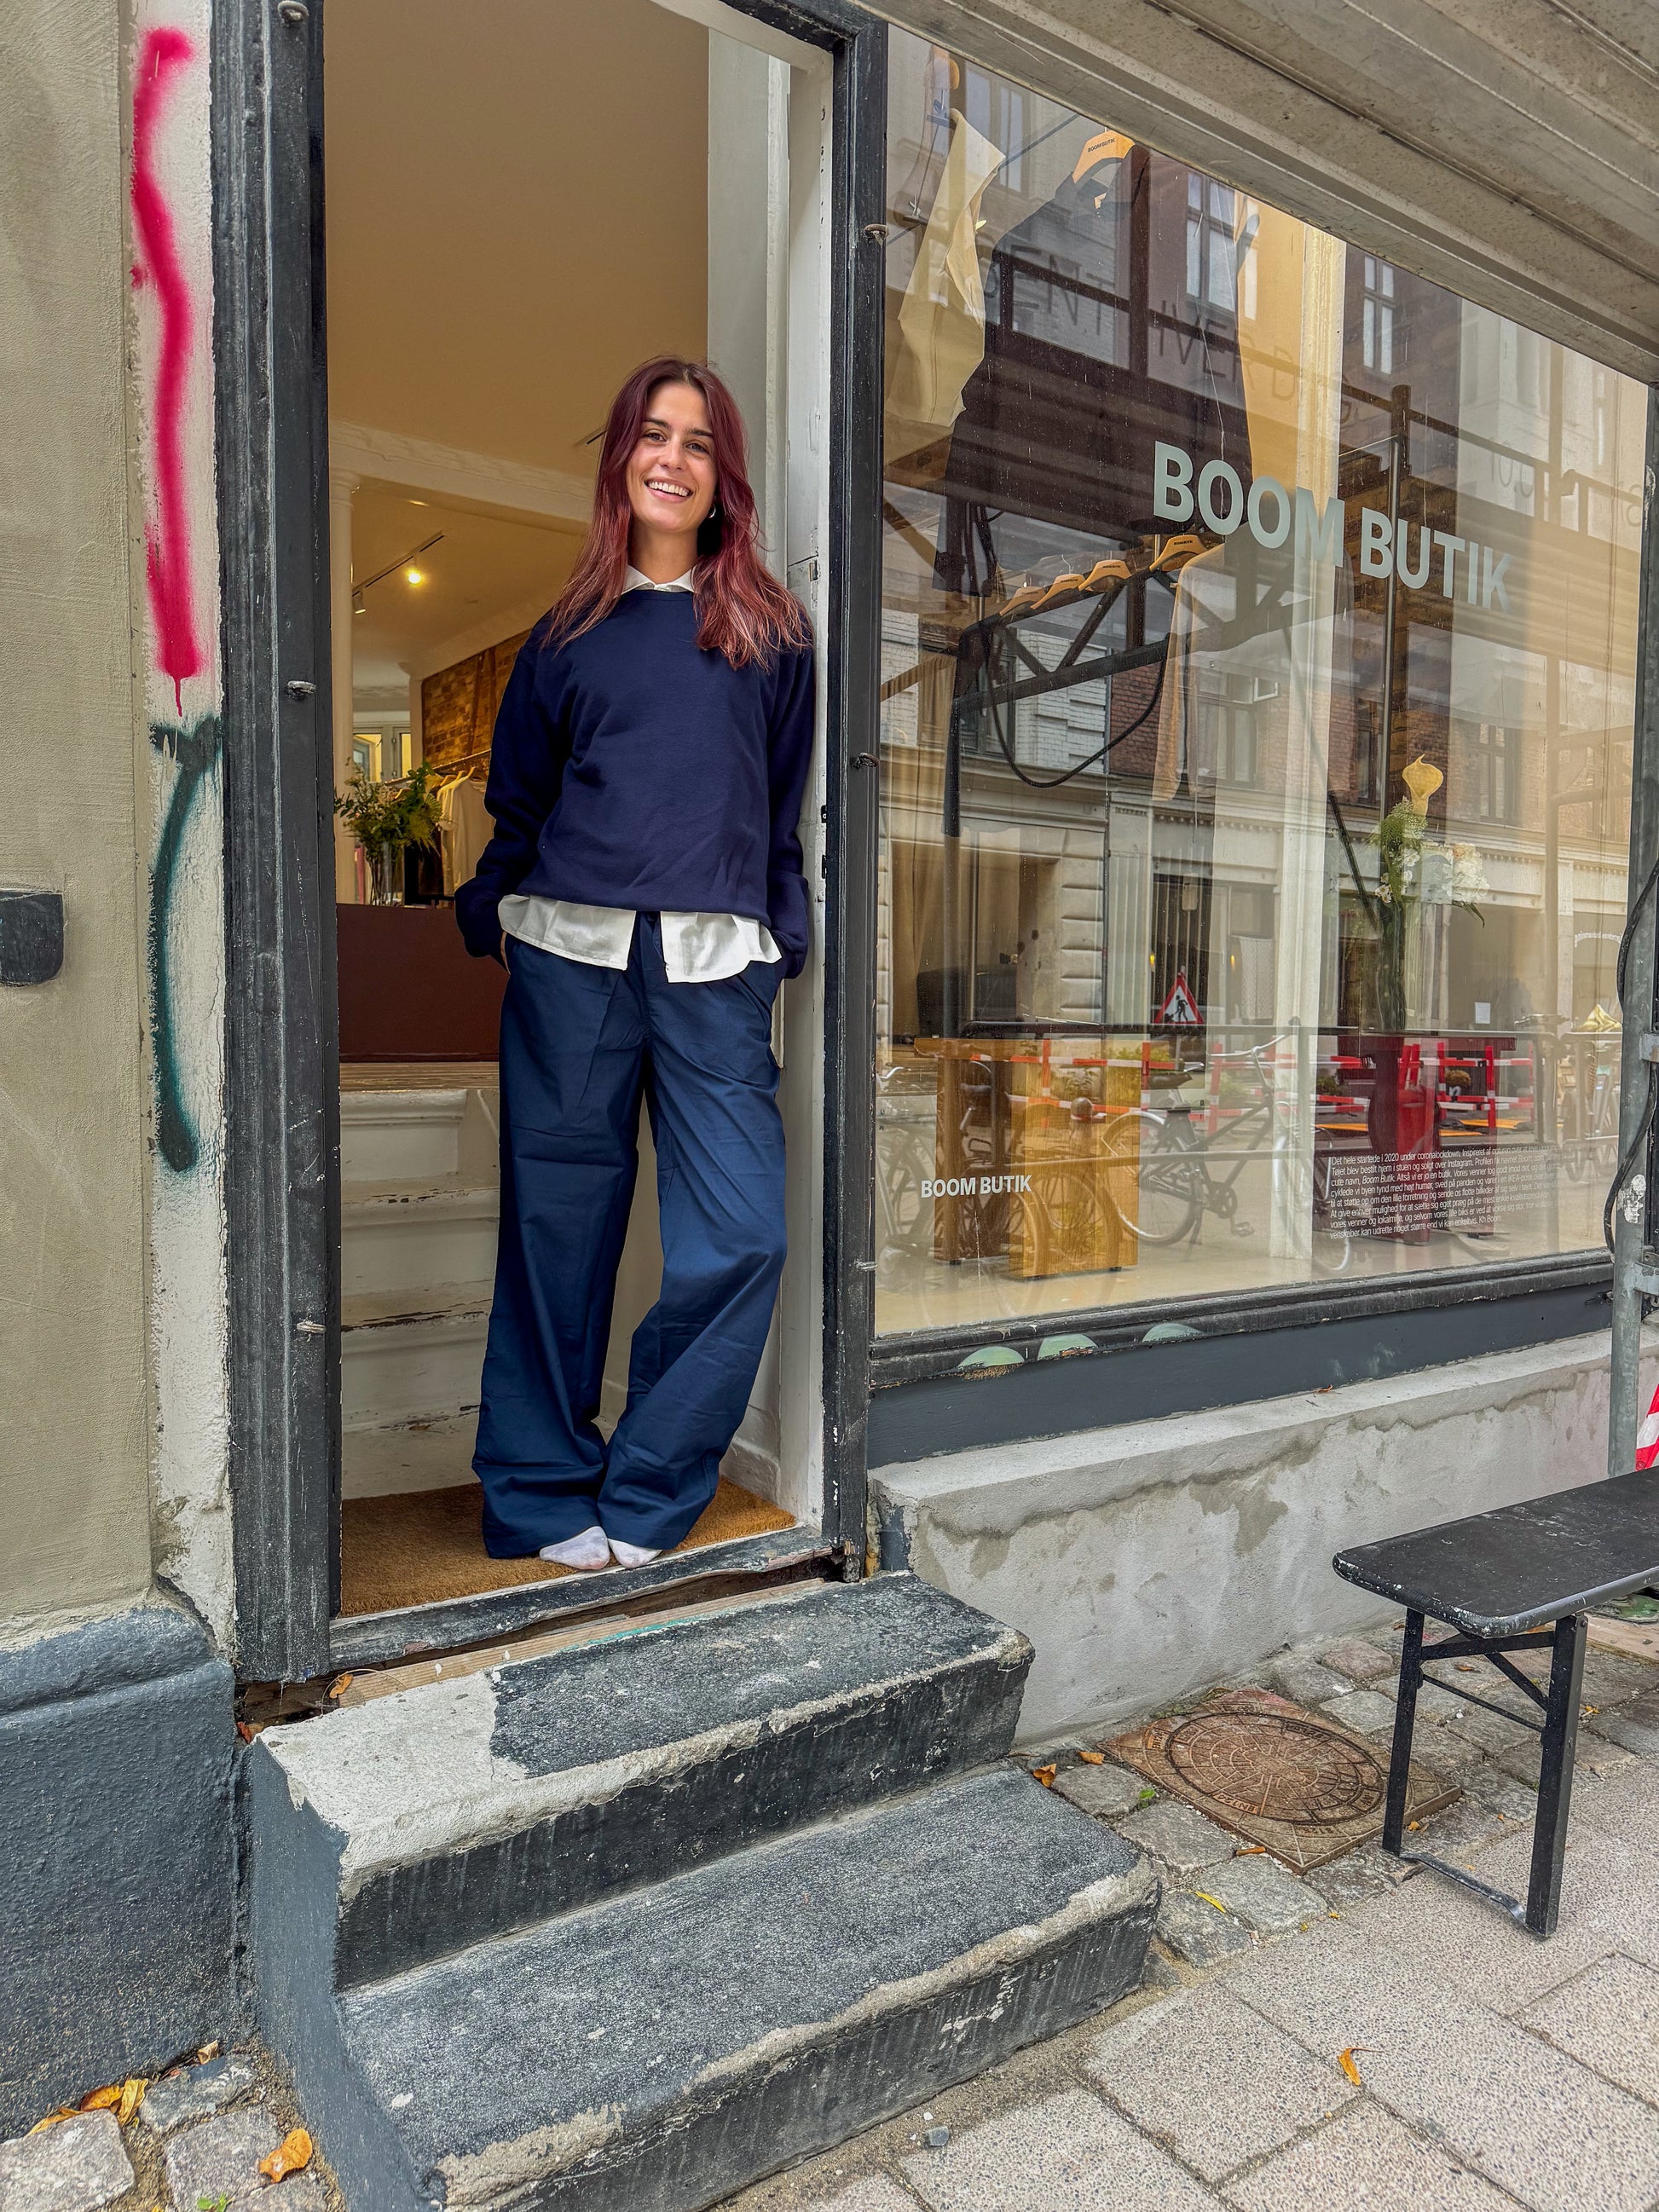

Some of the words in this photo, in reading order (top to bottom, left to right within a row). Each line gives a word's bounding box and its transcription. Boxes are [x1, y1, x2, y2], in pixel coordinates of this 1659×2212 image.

[1153, 441, 1344, 568] BOOM
[1361, 506, 1513, 614] BUTIK
[1332, 1157, 1342, 1165] Det
[1357, 1154, 1380, 1164] startede
[1400, 1152, 1416, 1161] under
[1417, 1150, 1460, 1159] coronalockdown.
[1462, 1148, 1485, 1158] Inspireret
[1331, 1178, 1344, 1187] cute
[1362, 1175, 1379, 1184] Boom
[1381, 1174, 1396, 1182] Butik.
[1396, 1172, 1410, 1181] Altså
[1424, 1171, 1429, 1181] jo
[1438, 1170, 1452, 1178] butik.
[1332, 1167, 1345, 1177] Tøjet
[1361, 1164, 1377, 1174] bestilt
[1378, 1164, 1391, 1174] hjem
[1421, 1162, 1434, 1170] solgt
[1448, 1160, 1473, 1169] Instagram.
[921, 1177, 976, 1198] BOOM
[980, 1175, 1032, 1194] BUTIK
[1331, 1187, 1354, 1198] cyklede
[1361, 1186, 1375, 1196] byen
[1376, 1185, 1389, 1195] tynd
[1390, 1184, 1402, 1193] med
[1404, 1183, 1414, 1193] højt
[1435, 1180, 1448, 1189] sved
[1449, 1179, 1455, 1188] på
[1457, 1178, 1476, 1187] panden
[1477, 1178, 1483, 1187] og
[1344, 1198, 1360, 1207] støtte
[1361, 1198, 1369, 1206] op
[1381, 1195, 1391, 1204] den
[1393, 1193, 1402, 1202] lille
[1402, 1193, 1428, 1202] forretning
[1437, 1190, 1454, 1198] sende
[1462, 1187, 1475, 1196] flotte
[1476, 1187, 1494, 1195] billeder
[1330, 1210, 1337, 1219] At
[1338, 1209, 1350, 1220] give
[1351, 1208, 1372, 1216] enhver
[1373, 1204, 1397, 1215] mulighed
[1408, 1203, 1413, 1211] at
[1414, 1202, 1430, 1210] sætte
[1431, 1200, 1439, 1210] sig
[1439, 1201, 1452, 1210] eget
[1452, 1199, 1466, 1209] præg
[1467, 1197, 1474, 1206] på
[1347, 1218, 1367, 1227] venner
[1368, 1218, 1377, 1227] og
[1405, 1214, 1412, 1222] og
[1413, 1211, 1433, 1220] selvom
[1449, 1209, 1458, 1217] lille
[1458, 1207, 1468, 1216] biks
[1476, 1205, 1485, 1215] ved
[1330, 1229, 1360, 1239] venskaber
[1361, 1227, 1372, 1236] kan
[1373, 1226, 1392, 1235] udrette
[1394, 1224, 1409, 1234] noget
[1410, 1222, 1426, 1231] større
[1427, 1221, 1437, 1229] end
[1454, 1216, 1477, 1227] enkeltvis.
[1478, 1215, 1486, 1223] Kh
[1487, 1214, 1502, 1222] Boom
[1217, 1793, 1256, 1812] EN124
